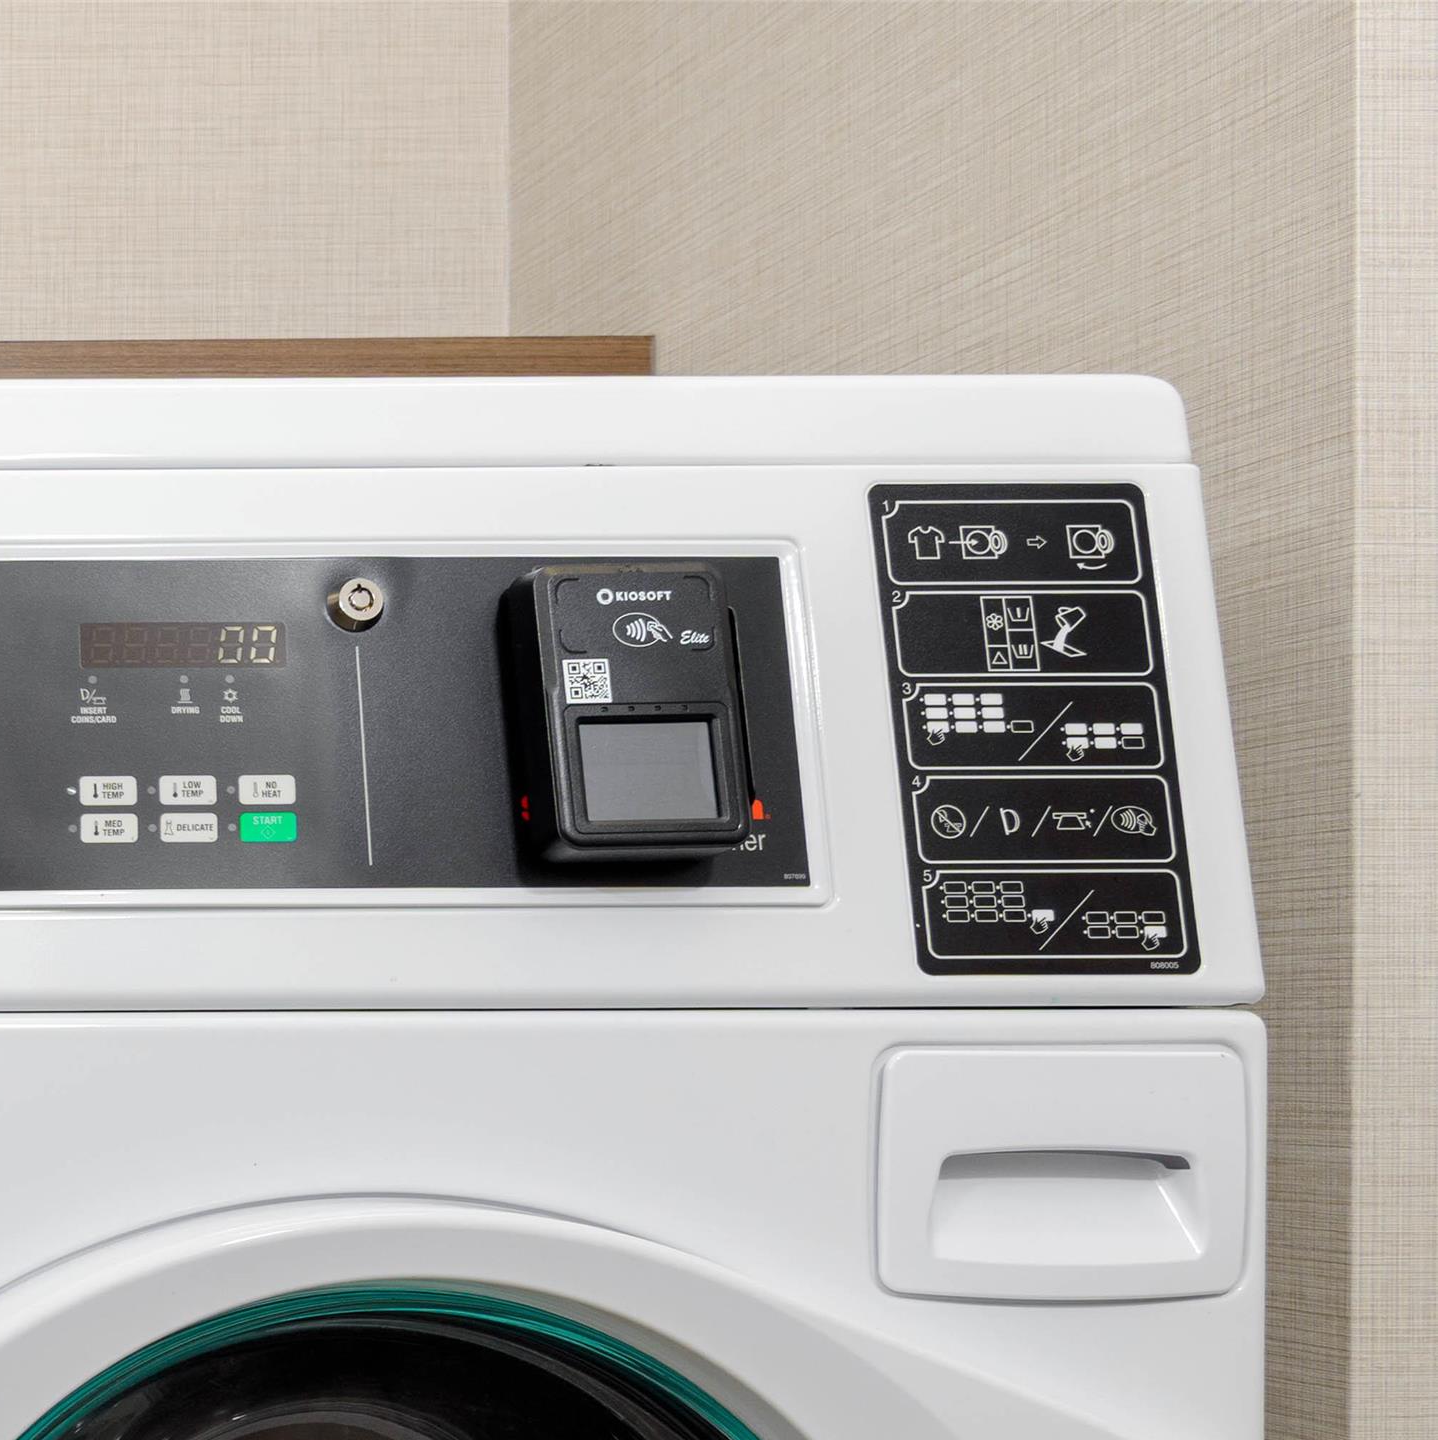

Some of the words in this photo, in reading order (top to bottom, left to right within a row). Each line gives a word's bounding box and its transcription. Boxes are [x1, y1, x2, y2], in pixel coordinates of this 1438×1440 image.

[882, 500, 889, 512] 1
[615, 591, 673, 601] KIOSOFT
[891, 591, 901, 602] 2
[679, 630, 710, 645] Elite
[902, 682, 912, 694] 3
[80, 707, 108, 715] INSERT
[170, 706, 201, 715] DRYING
[220, 706, 242, 715] COOL
[219, 715, 244, 724] DOWN
[182, 781, 202, 790] LOW
[265, 781, 278, 790] NO
[911, 775, 921, 787] 4
[102, 783, 123, 791] HIGH
[102, 791, 124, 800] TEMP
[181, 789, 204, 799] TEMP
[261, 790, 282, 799] HEAT
[104, 820, 123, 828] MED
[252, 815, 283, 826] START
[176, 822, 214, 833] DELICATE
[102, 828, 125, 837] TEMP
[923, 870, 932, 882] 5
